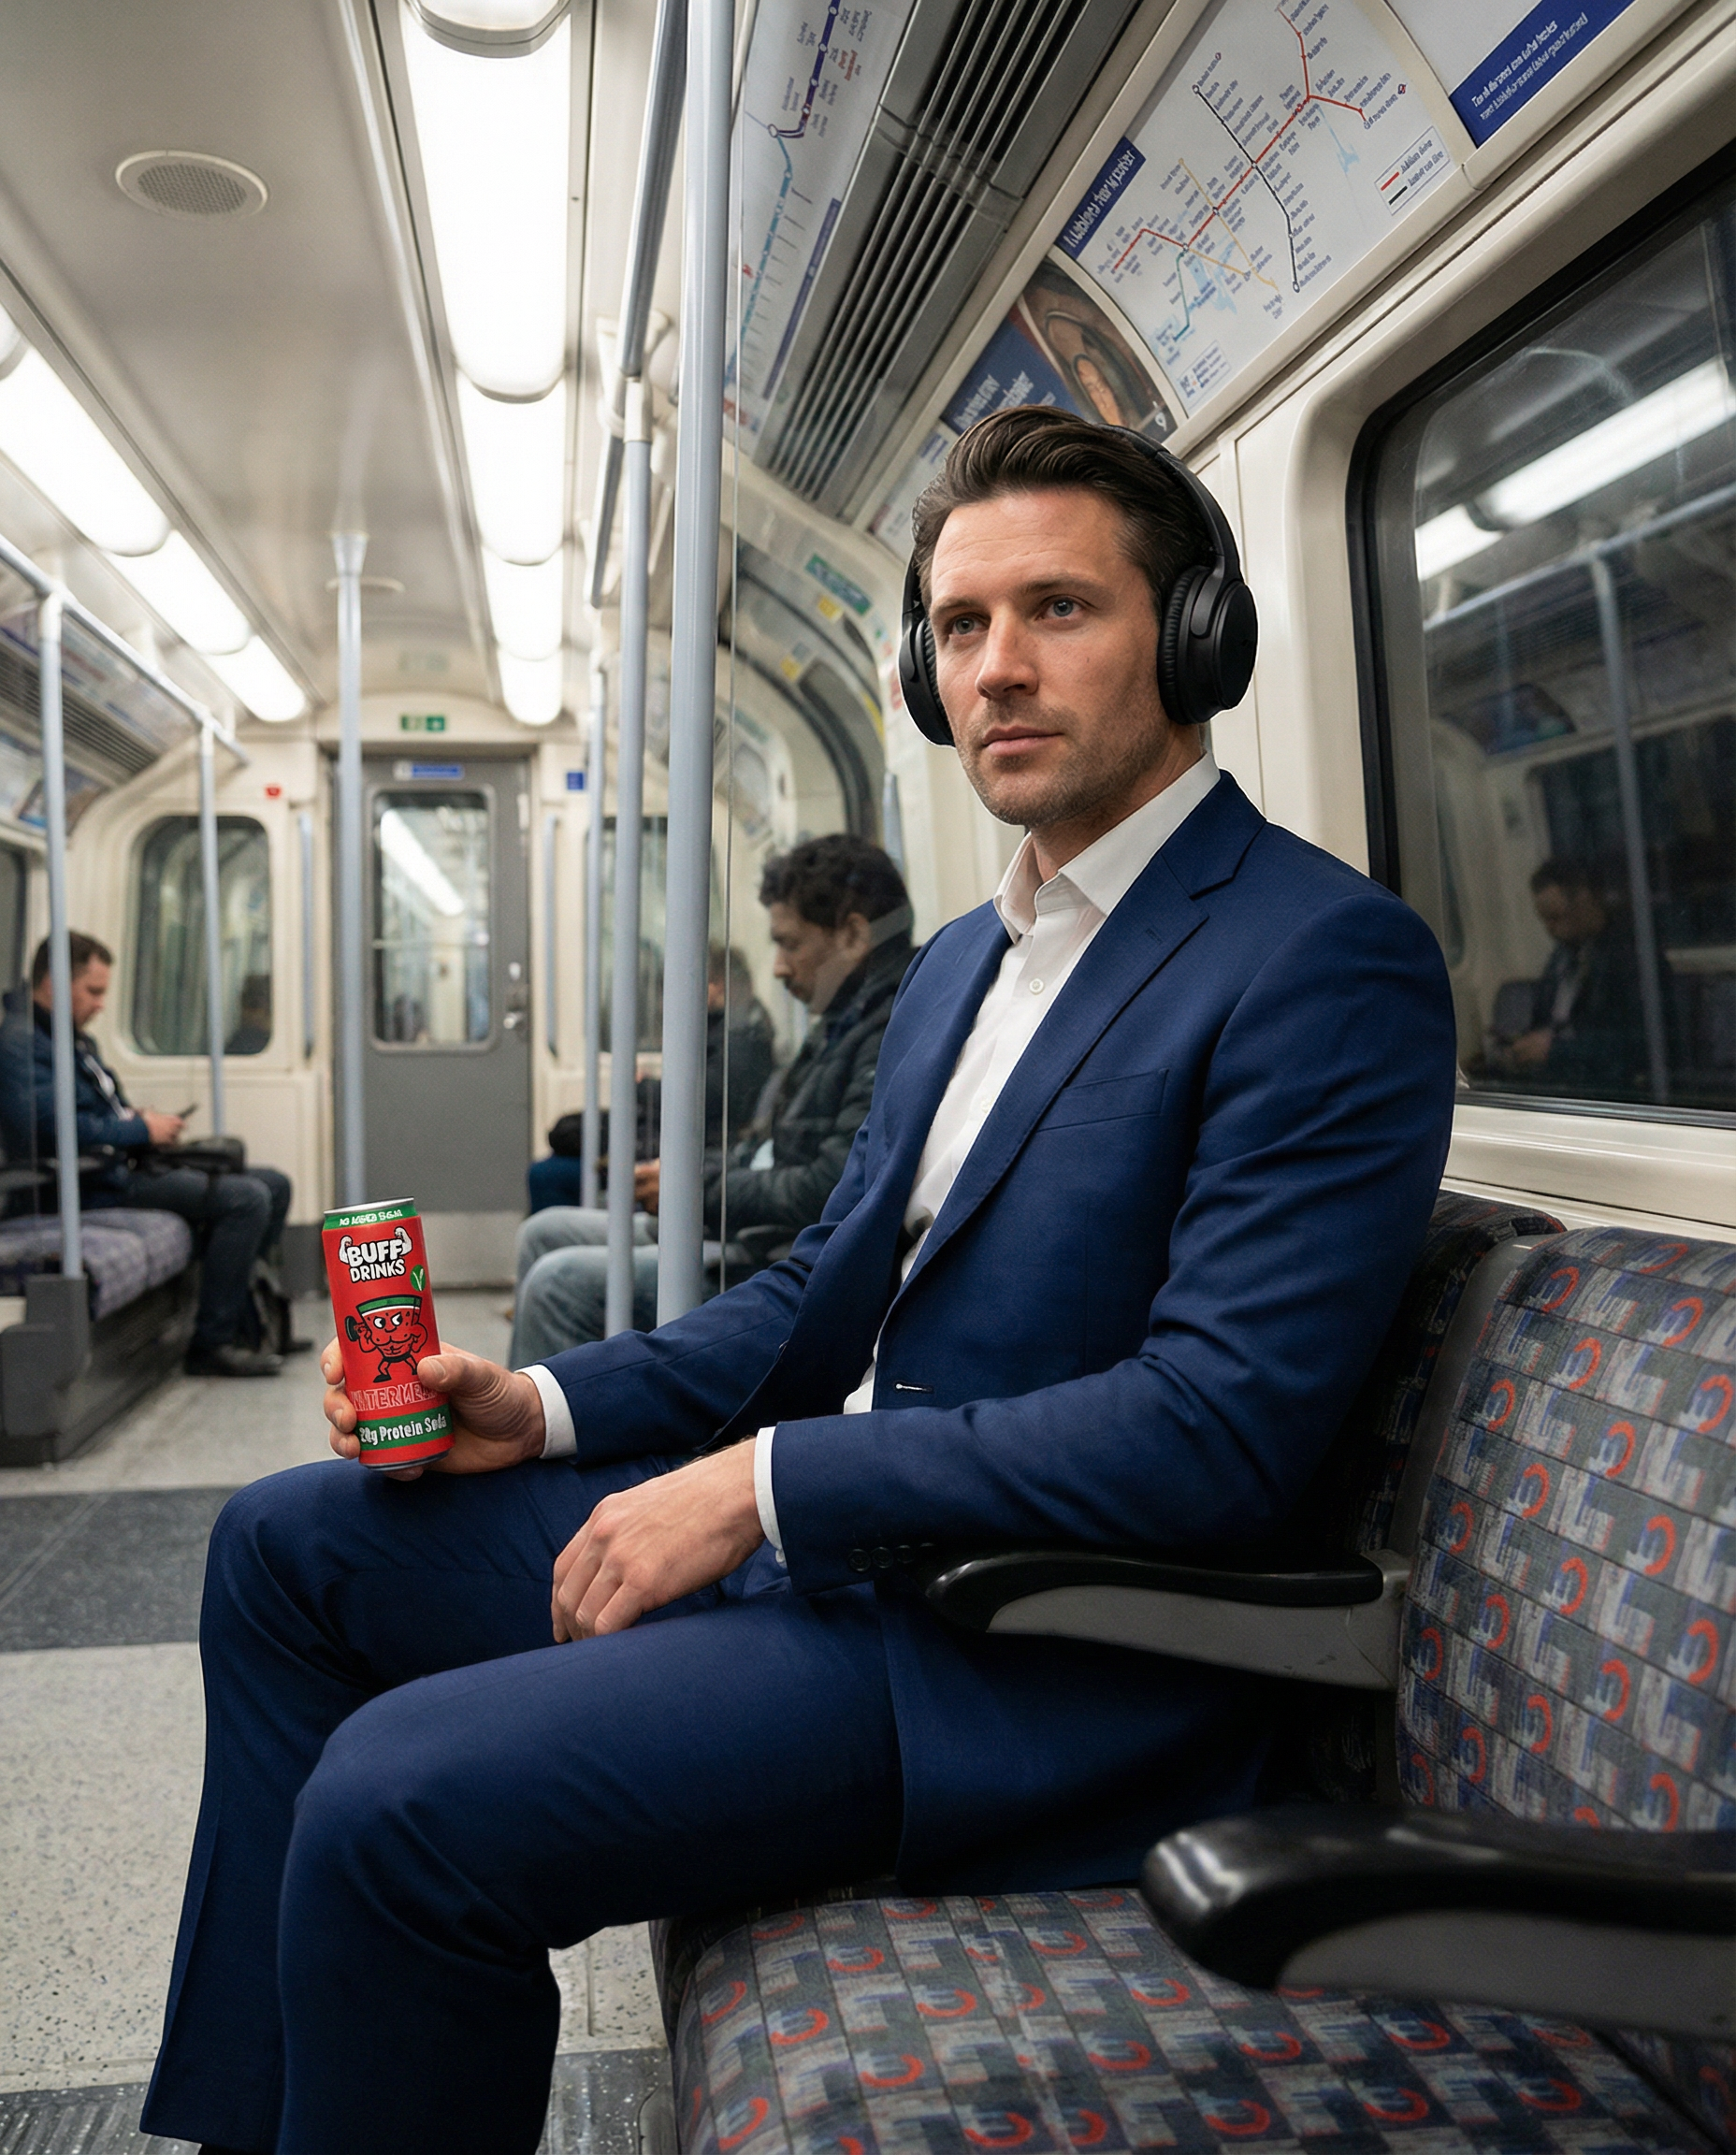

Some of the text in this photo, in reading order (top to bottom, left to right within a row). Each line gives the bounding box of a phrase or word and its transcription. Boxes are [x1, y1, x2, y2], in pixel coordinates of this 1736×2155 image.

[346, 1238, 403, 1267] BUFF
[350, 1258, 405, 1282] DRINKS
[379, 1421, 424, 1442] Protein
[424, 1413, 447, 1433] Soda
